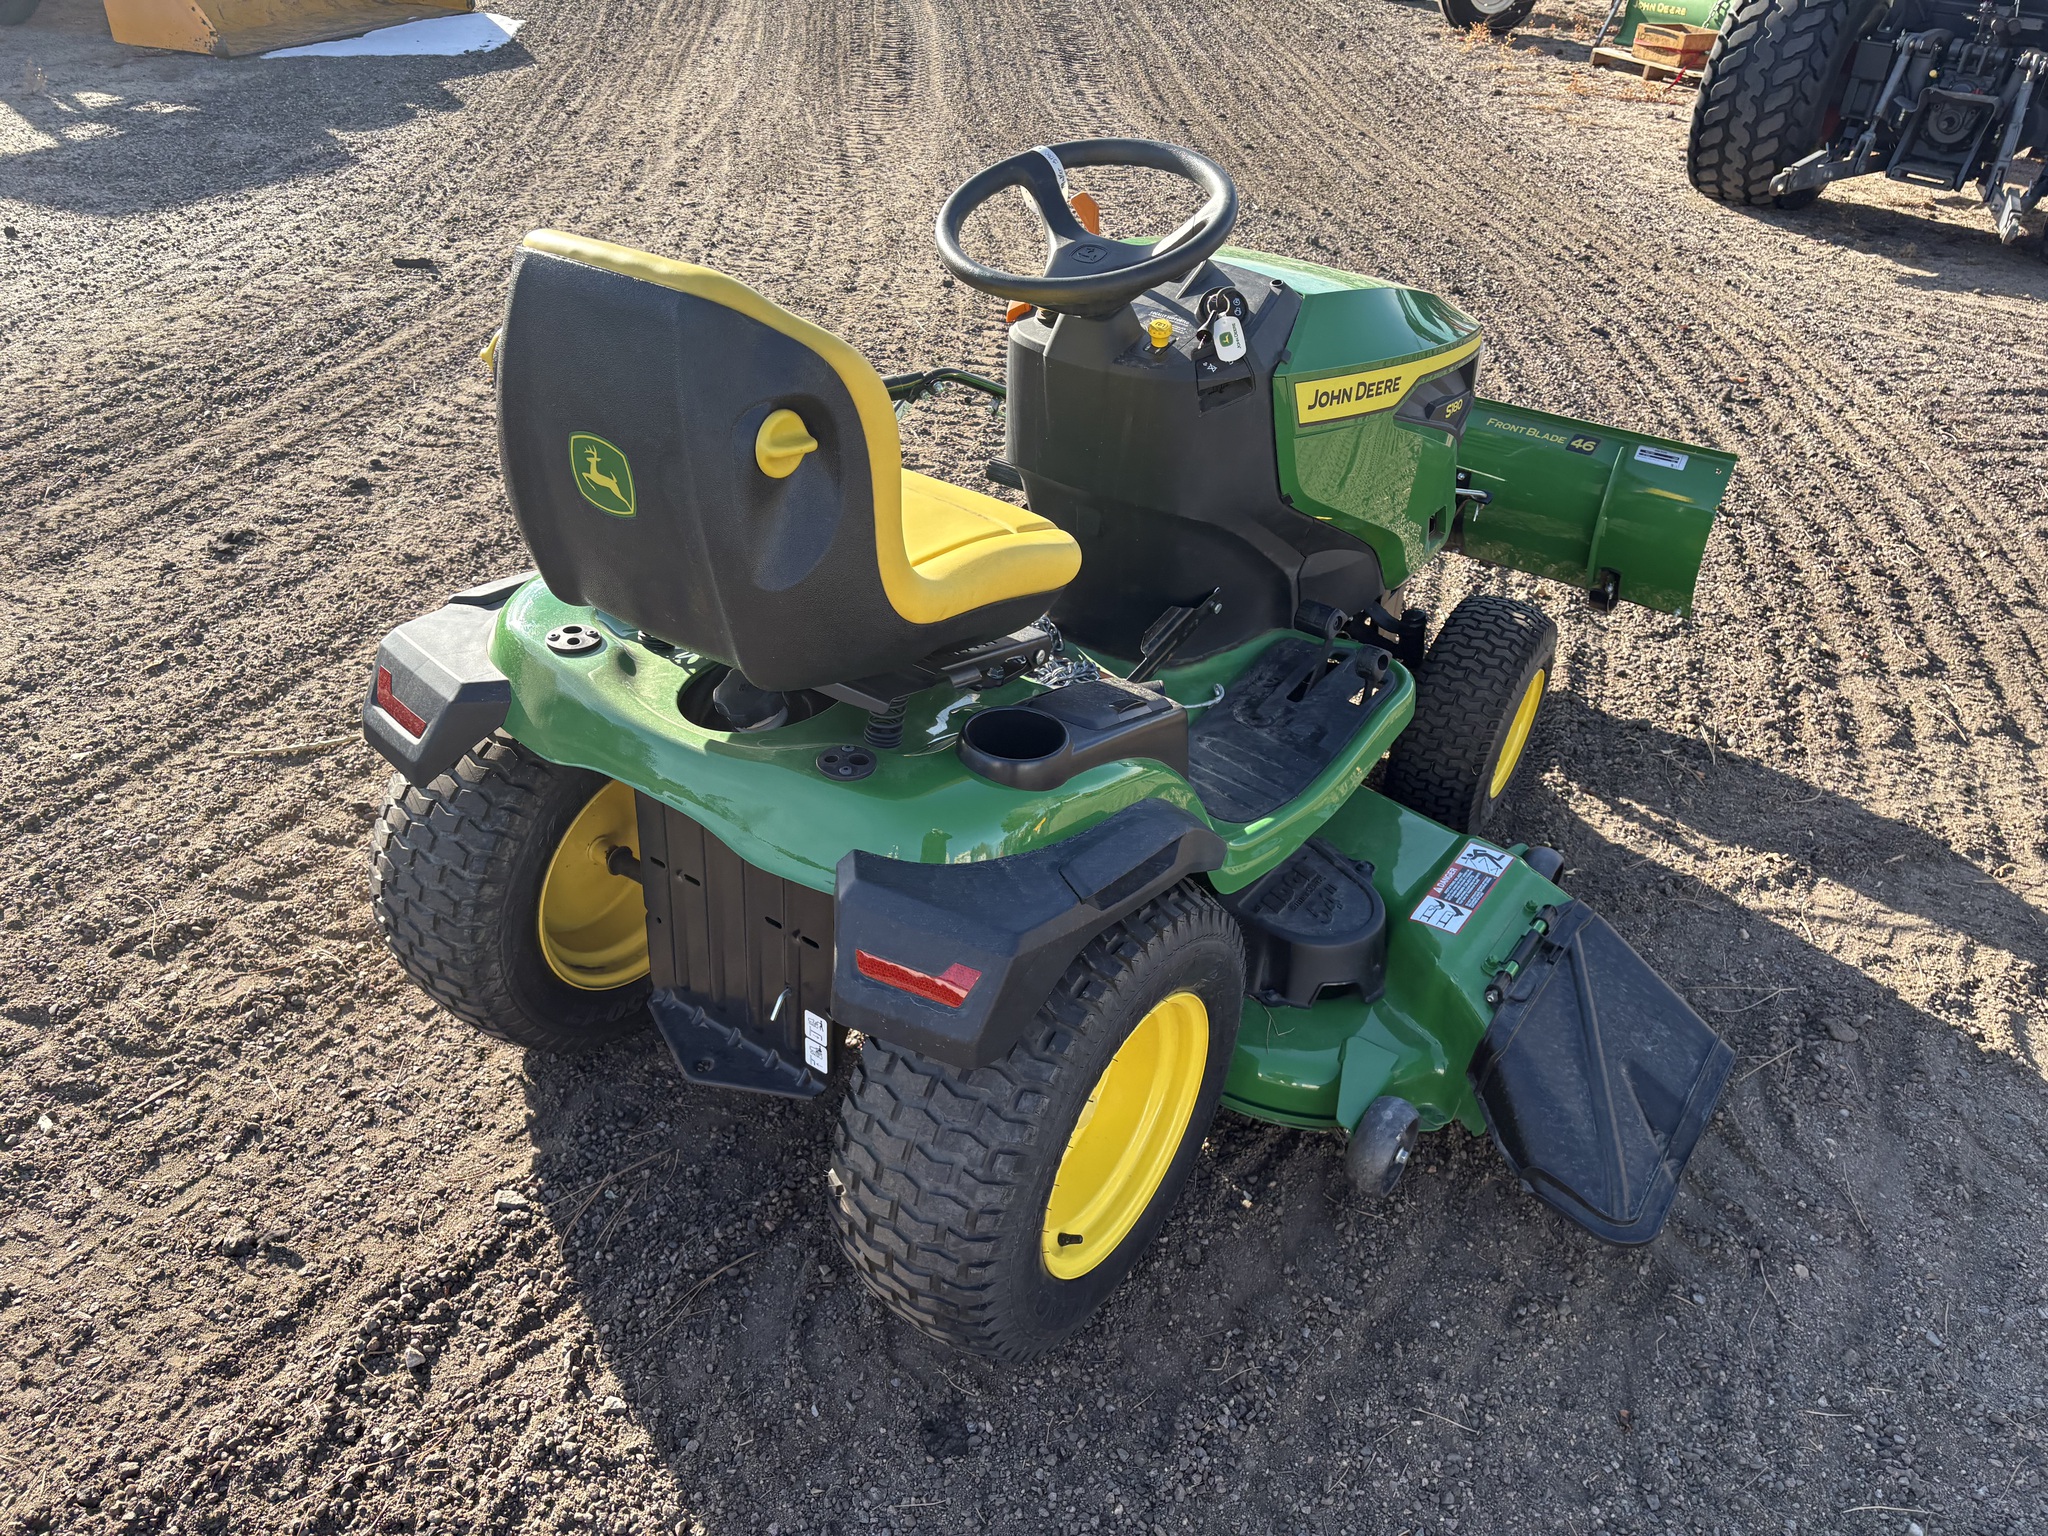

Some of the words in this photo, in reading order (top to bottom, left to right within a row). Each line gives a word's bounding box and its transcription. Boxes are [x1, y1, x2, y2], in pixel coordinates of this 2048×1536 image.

[1633, 0, 1657, 12] JOHN
[1657, 3, 1687, 16] DEERE
[1307, 386, 1353, 411] JOHN
[1355, 376, 1402, 402] DEERE
[1445, 398, 1463, 418] S180
[1486, 417, 1526, 434] FRONT
[1525, 427, 1568, 444] BLADE
[1570, 438, 1597, 452] 46
[1436, 867, 1458, 888] DANGER
